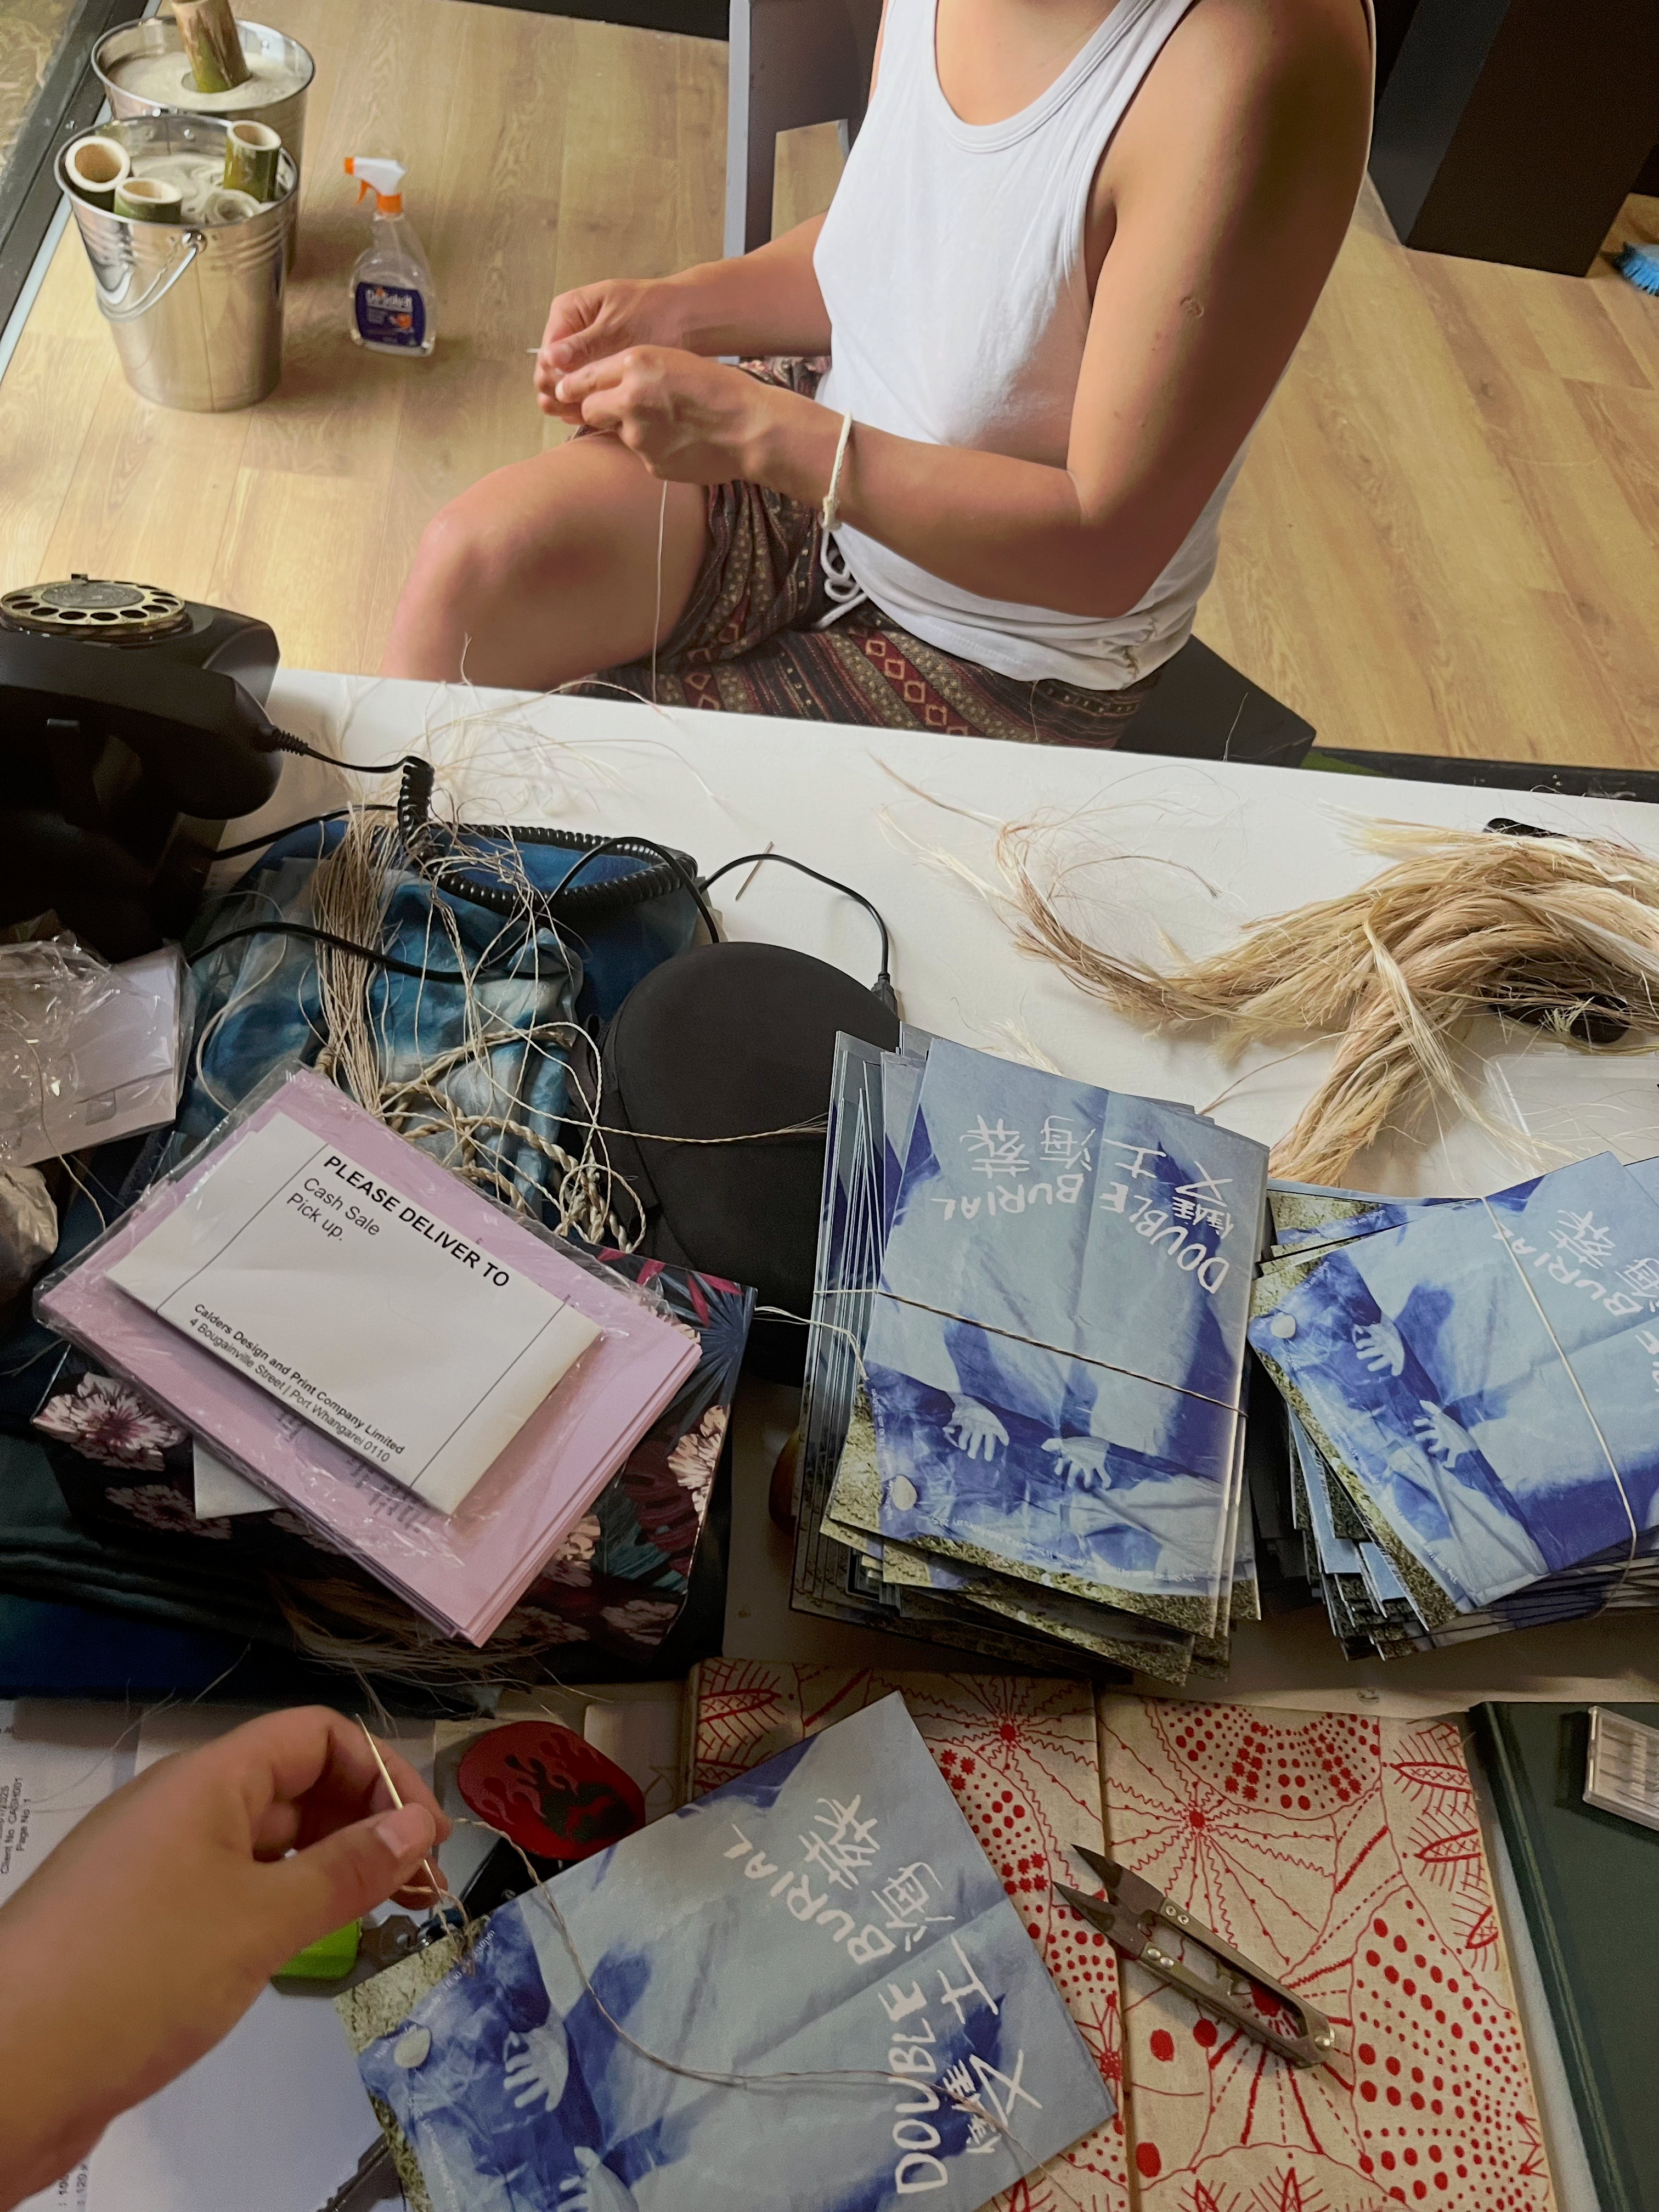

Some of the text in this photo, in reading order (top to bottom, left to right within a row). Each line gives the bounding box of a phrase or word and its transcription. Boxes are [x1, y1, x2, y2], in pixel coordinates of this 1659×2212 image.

[286, 1193, 344, 1242] Pick up.
[303, 1178, 381, 1236] Cash Sale
[324, 1156, 510, 1286] PLEASE DELIVER TO
[930, 1173, 1229, 1294] DOUBLE BURIAL
[190, 1318, 199, 1327] 4
[198, 1323, 255, 1368] Bougainville
[255, 1364, 286, 1390] Street
[289, 1389, 312, 1409] Port
[312, 1404, 365, 1446] Whangarei
[363, 1441, 390, 1462] 0110
[195, 1304, 233, 1334] Calders
[233, 1331, 269, 1361] Design
[269, 1358, 292, 1375] and
[290, 1371, 317, 1395] Print
[317, 1391, 365, 1429] Company
[364, 1424, 405, 1454] Limited
[15, 1826, 29, 1851] Page
[724, 1824, 948, 2193] DOUBLE BURIAL
